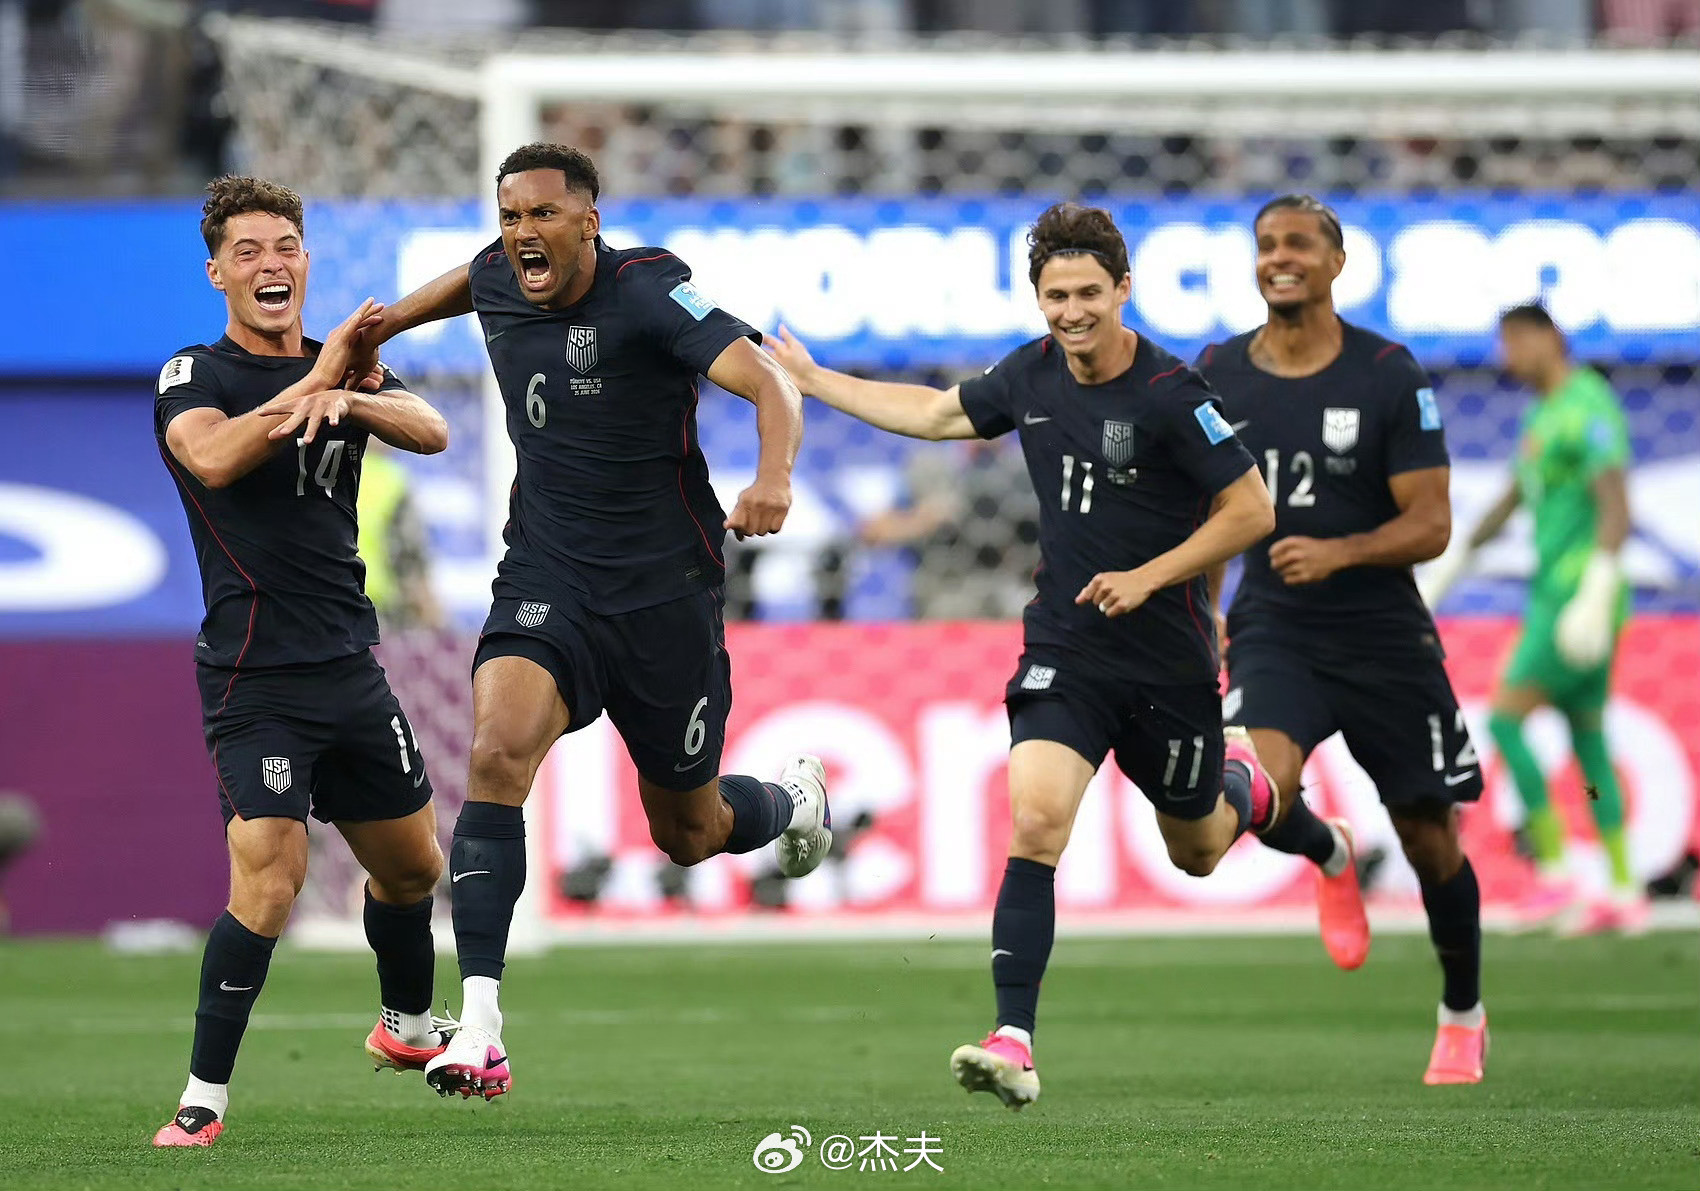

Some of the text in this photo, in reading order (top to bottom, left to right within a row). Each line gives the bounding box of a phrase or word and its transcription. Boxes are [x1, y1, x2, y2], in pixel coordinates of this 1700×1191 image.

[664, 225, 1048, 337] WORL
[570, 328, 594, 348] USA
[526, 372, 547, 429] 6
[1105, 423, 1132, 443] USA
[296, 437, 345, 499] 14
[1060, 454, 1095, 514] 11
[1264, 448, 1316, 508] 12
[522, 603, 548, 614] USA
[684, 696, 708, 756] 6
[264, 759, 289, 774] USA
[1162, 735, 1204, 790] 11
